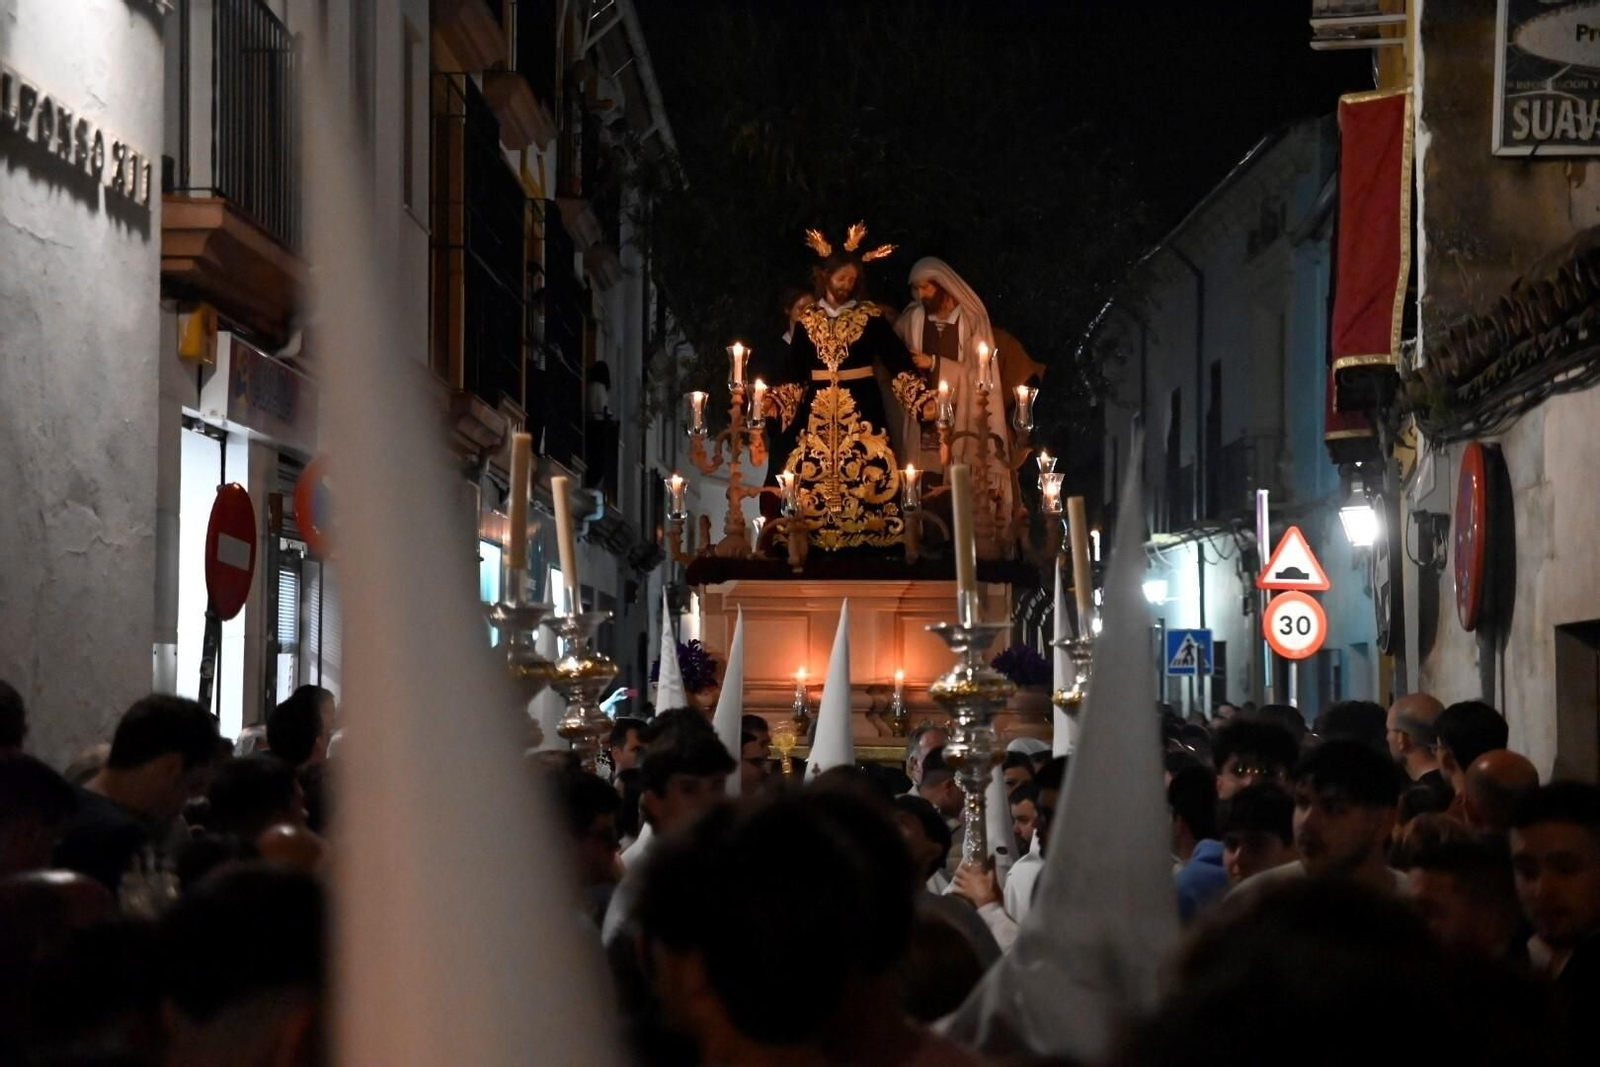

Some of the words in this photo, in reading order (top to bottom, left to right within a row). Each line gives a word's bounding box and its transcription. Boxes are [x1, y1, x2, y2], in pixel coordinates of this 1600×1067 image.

[1576, 23, 1600, 42] Pr
[1512, 99, 1600, 141] SUAV
[1279, 615, 1311, 635] 30
